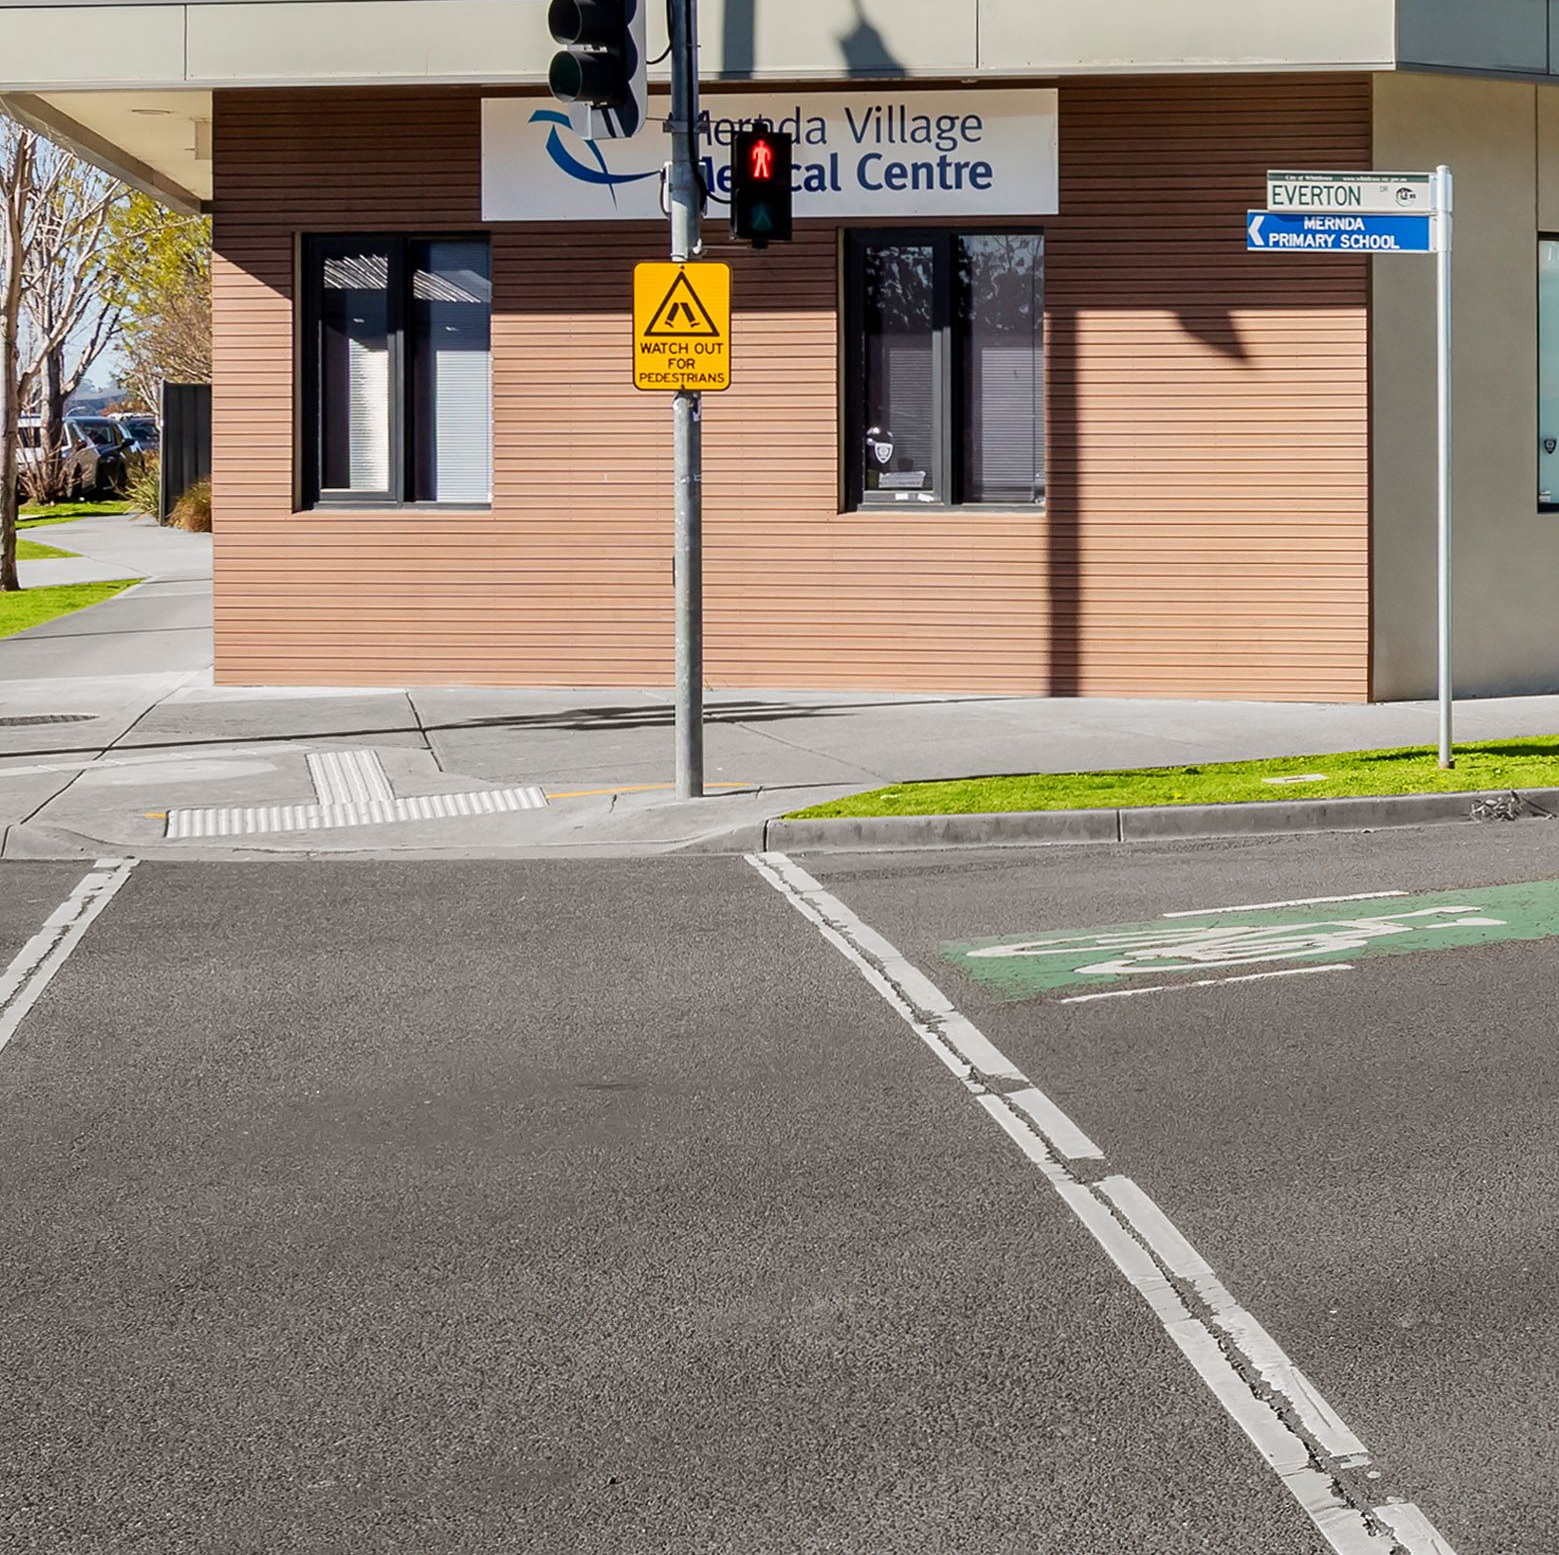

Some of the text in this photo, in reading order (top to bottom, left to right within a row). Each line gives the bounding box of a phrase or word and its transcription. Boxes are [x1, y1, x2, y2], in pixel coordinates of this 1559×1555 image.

[844, 105, 983, 152] Village
[857, 153, 993, 191] Centre
[1272, 185, 1361, 206] EVERTON
[1304, 217, 1365, 231] MERNDA
[1269, 233, 1400, 249] PRIMARY SCHOOL
[640, 342, 723, 355] WATCH OUT
[668, 358, 696, 369] FOR
[639, 373, 725, 383] PEDESTRIANS
